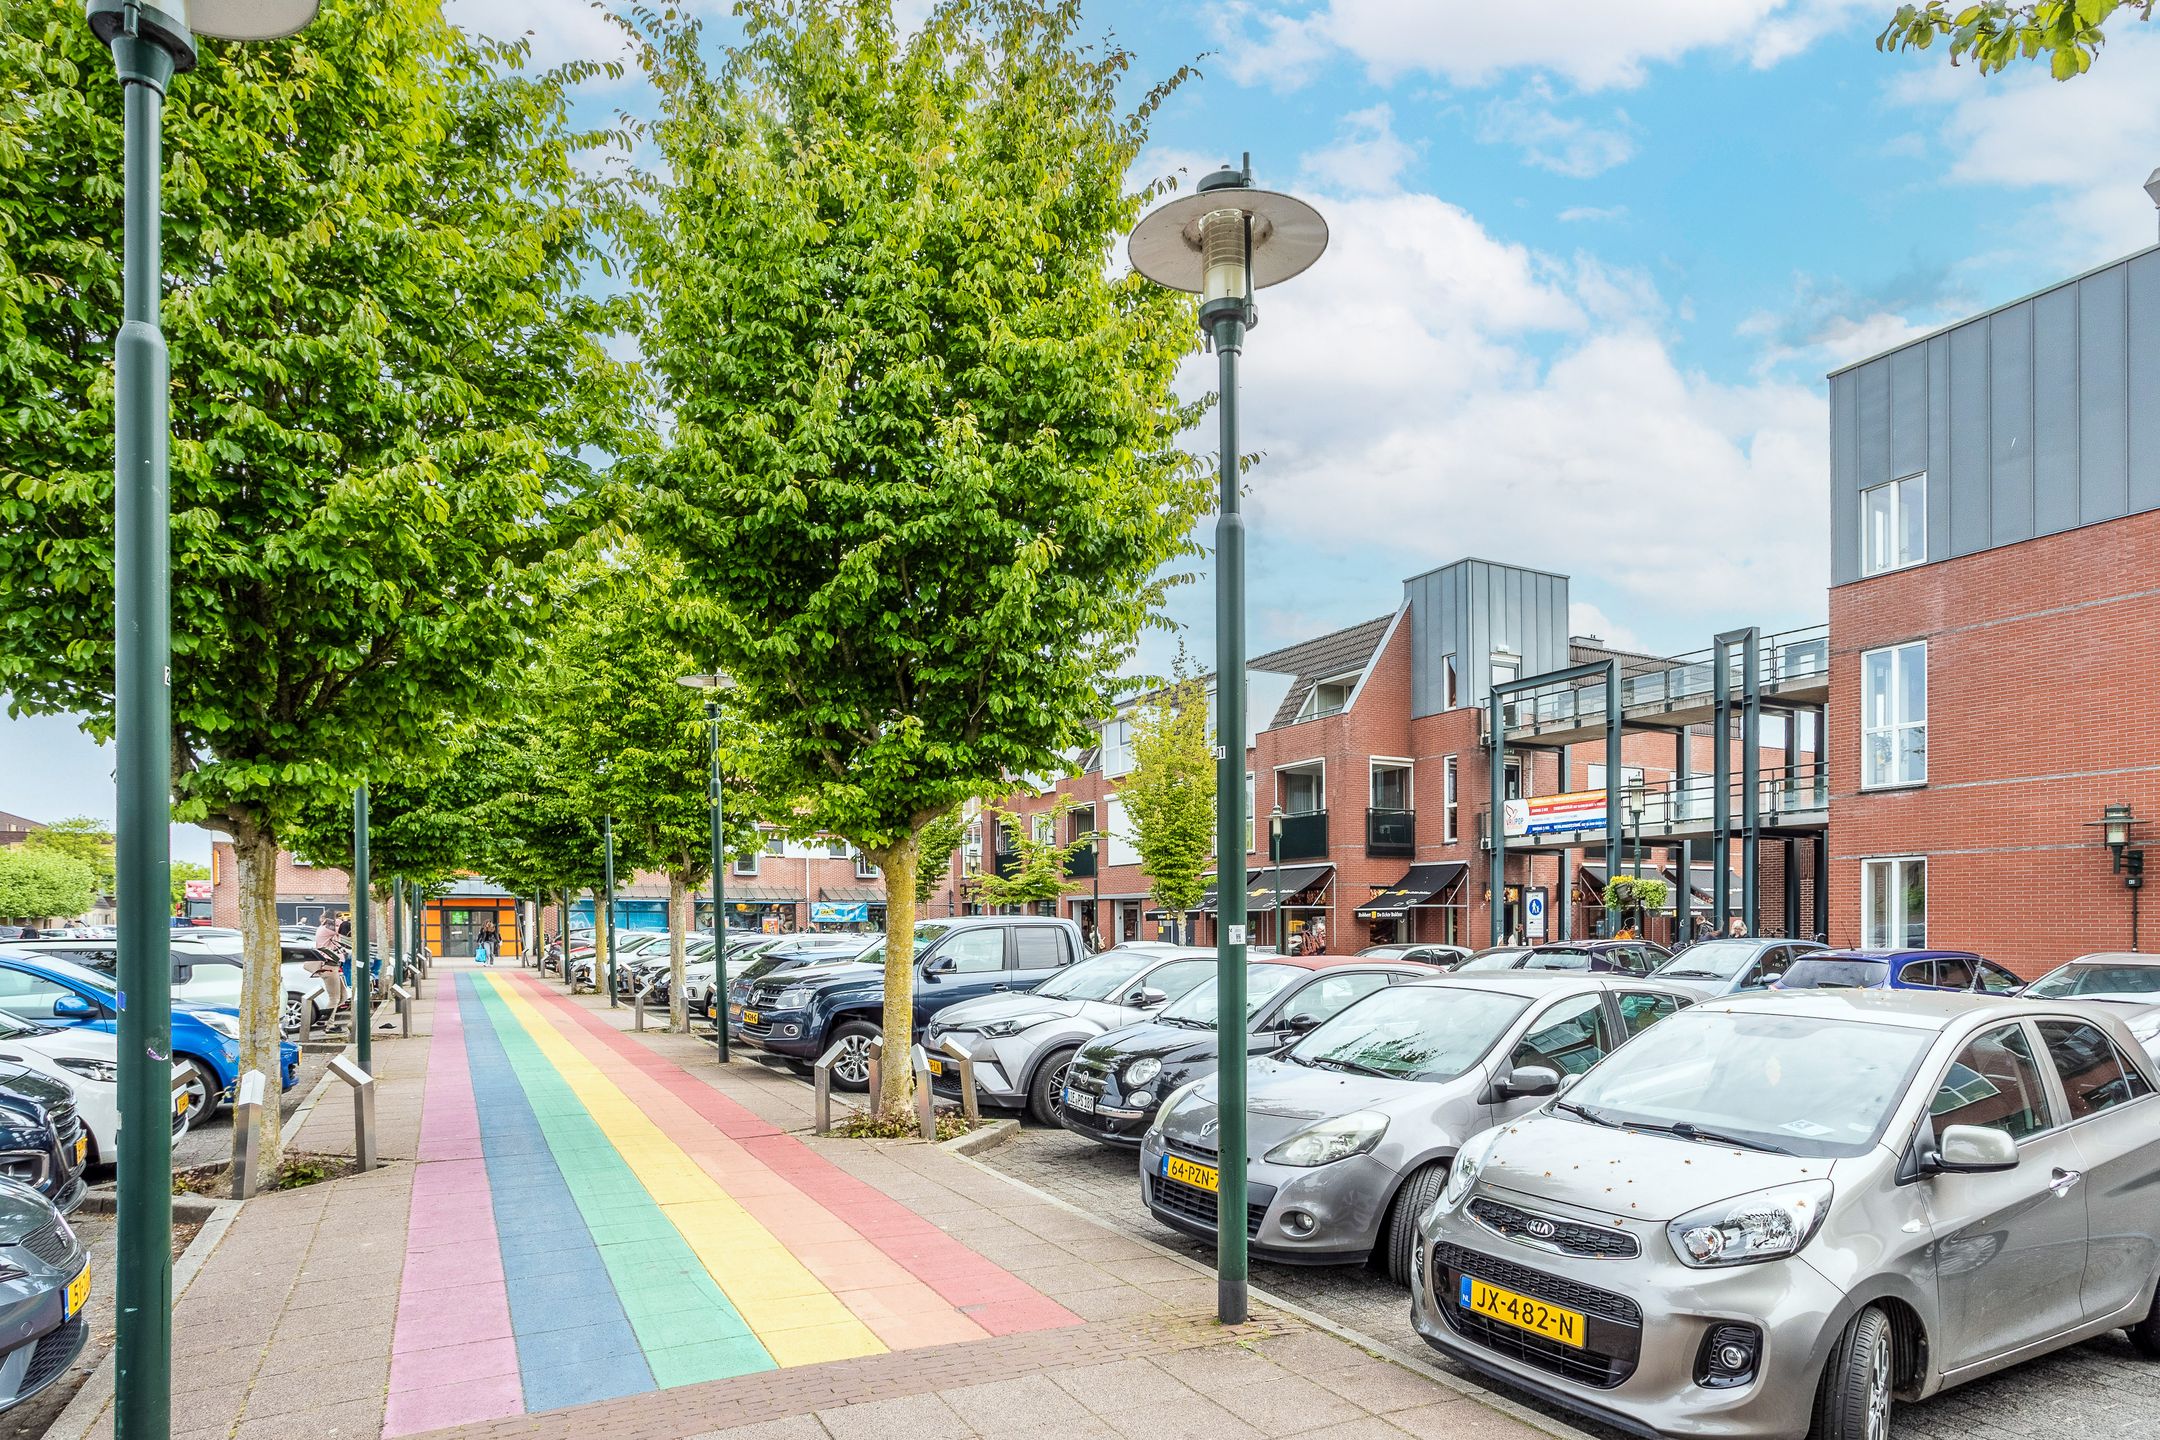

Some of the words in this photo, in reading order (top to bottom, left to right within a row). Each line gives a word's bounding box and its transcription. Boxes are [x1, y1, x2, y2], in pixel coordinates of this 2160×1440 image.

[1529, 1219, 1550, 1236] KIA
[1462, 1293, 1470, 1303] NL
[1476, 1287, 1574, 1339] JX-482-N
